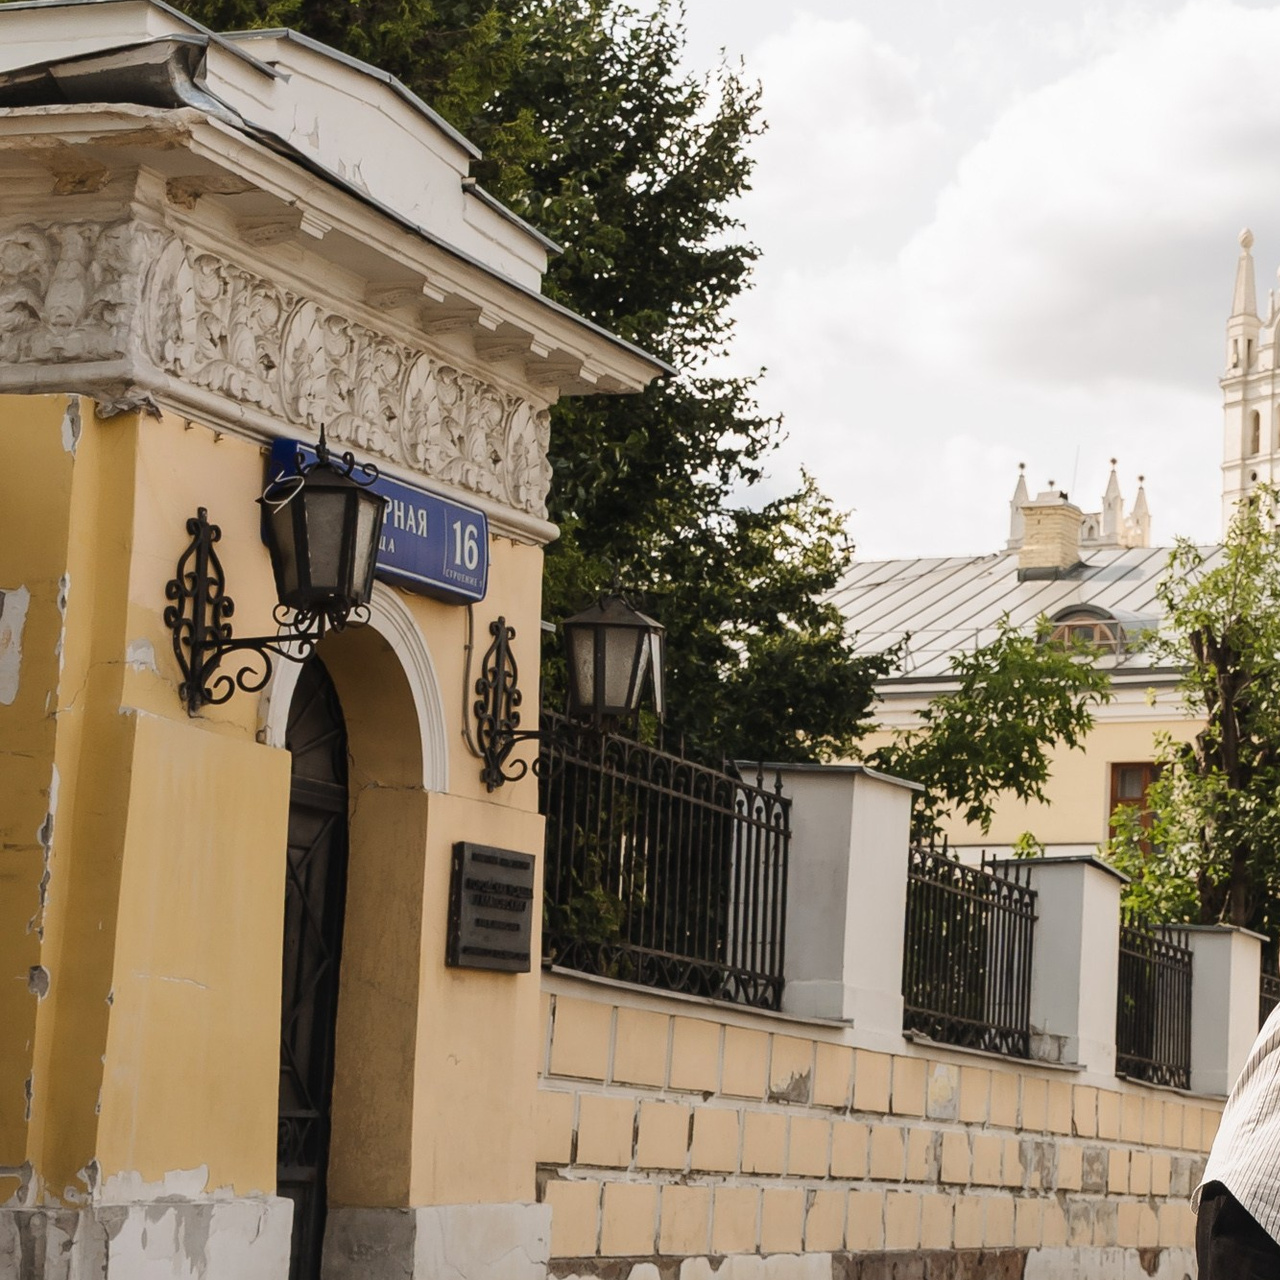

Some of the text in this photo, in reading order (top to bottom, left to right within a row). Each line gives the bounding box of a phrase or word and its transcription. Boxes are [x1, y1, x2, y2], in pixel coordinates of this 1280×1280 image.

[383, 495, 427, 537] РНАЯ
[379, 535, 395, 553] ЦА
[453, 520, 478, 570] 16
